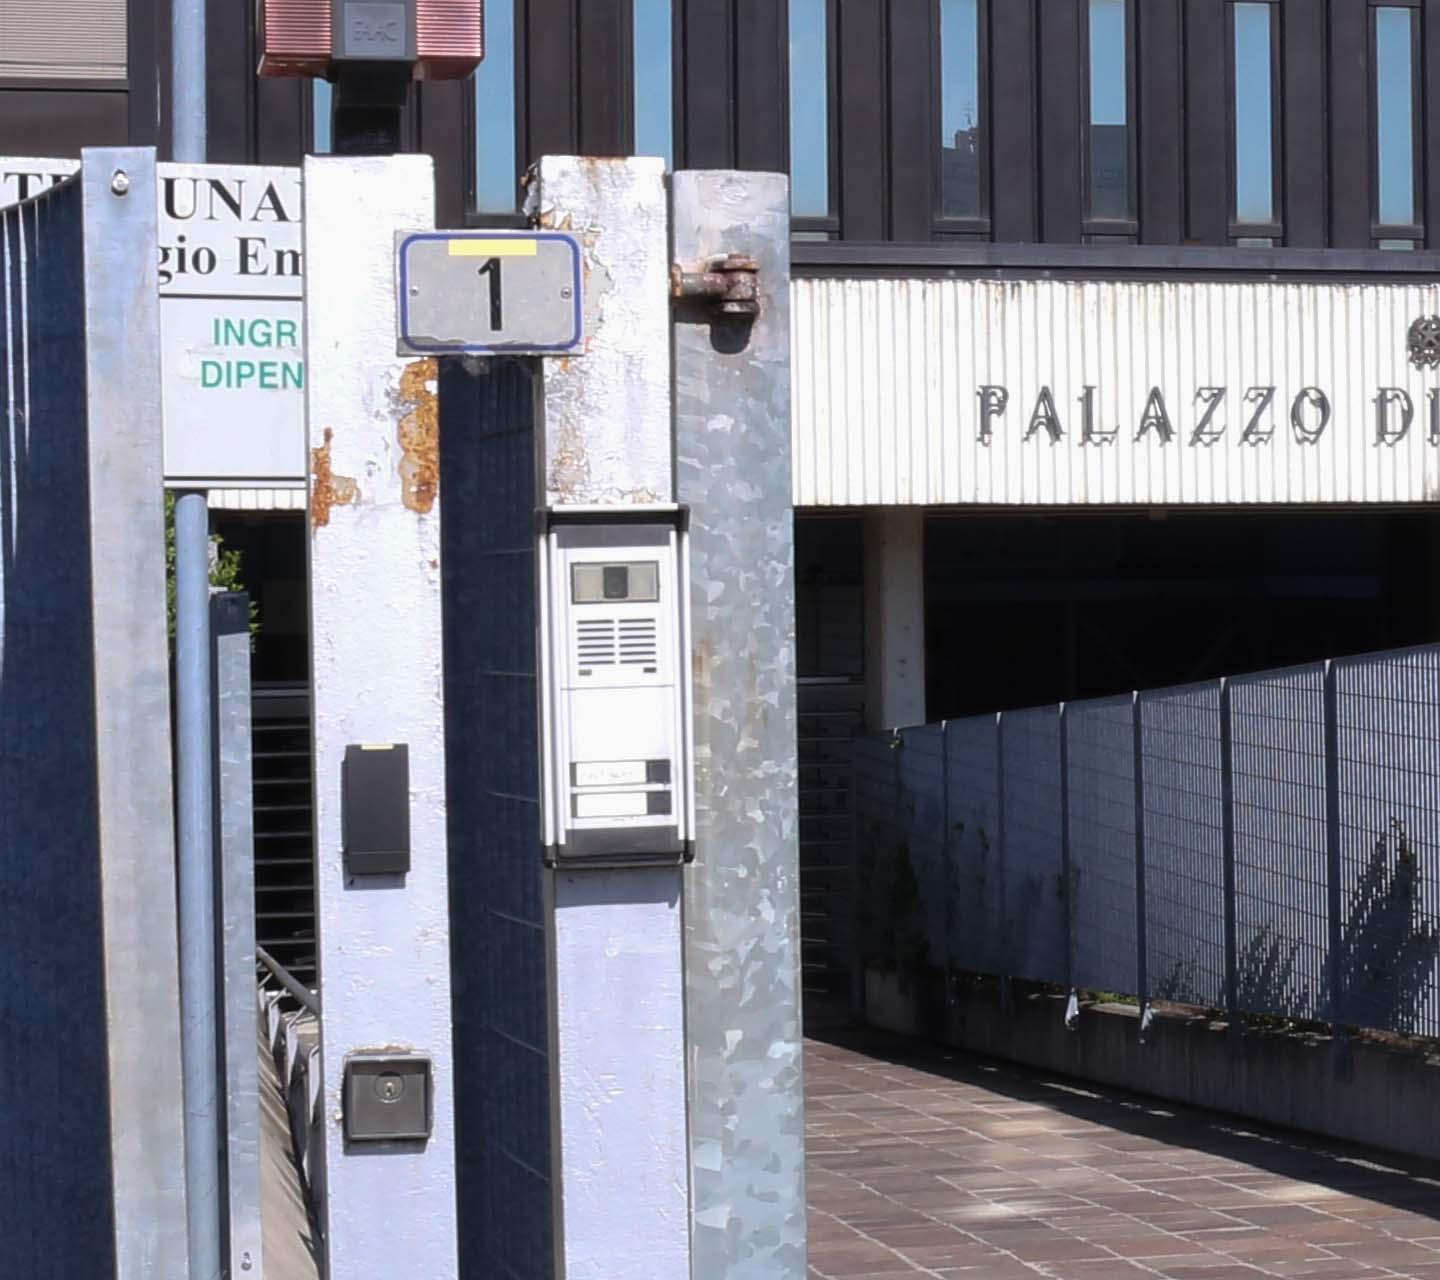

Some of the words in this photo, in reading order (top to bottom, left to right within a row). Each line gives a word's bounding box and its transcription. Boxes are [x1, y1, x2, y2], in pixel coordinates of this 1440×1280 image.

[478, 257, 503, 331] 1
[213, 318, 297, 347] INGR
[201, 360, 304, 389] DIPEN
[975, 383, 1333, 447] PALAZZO
